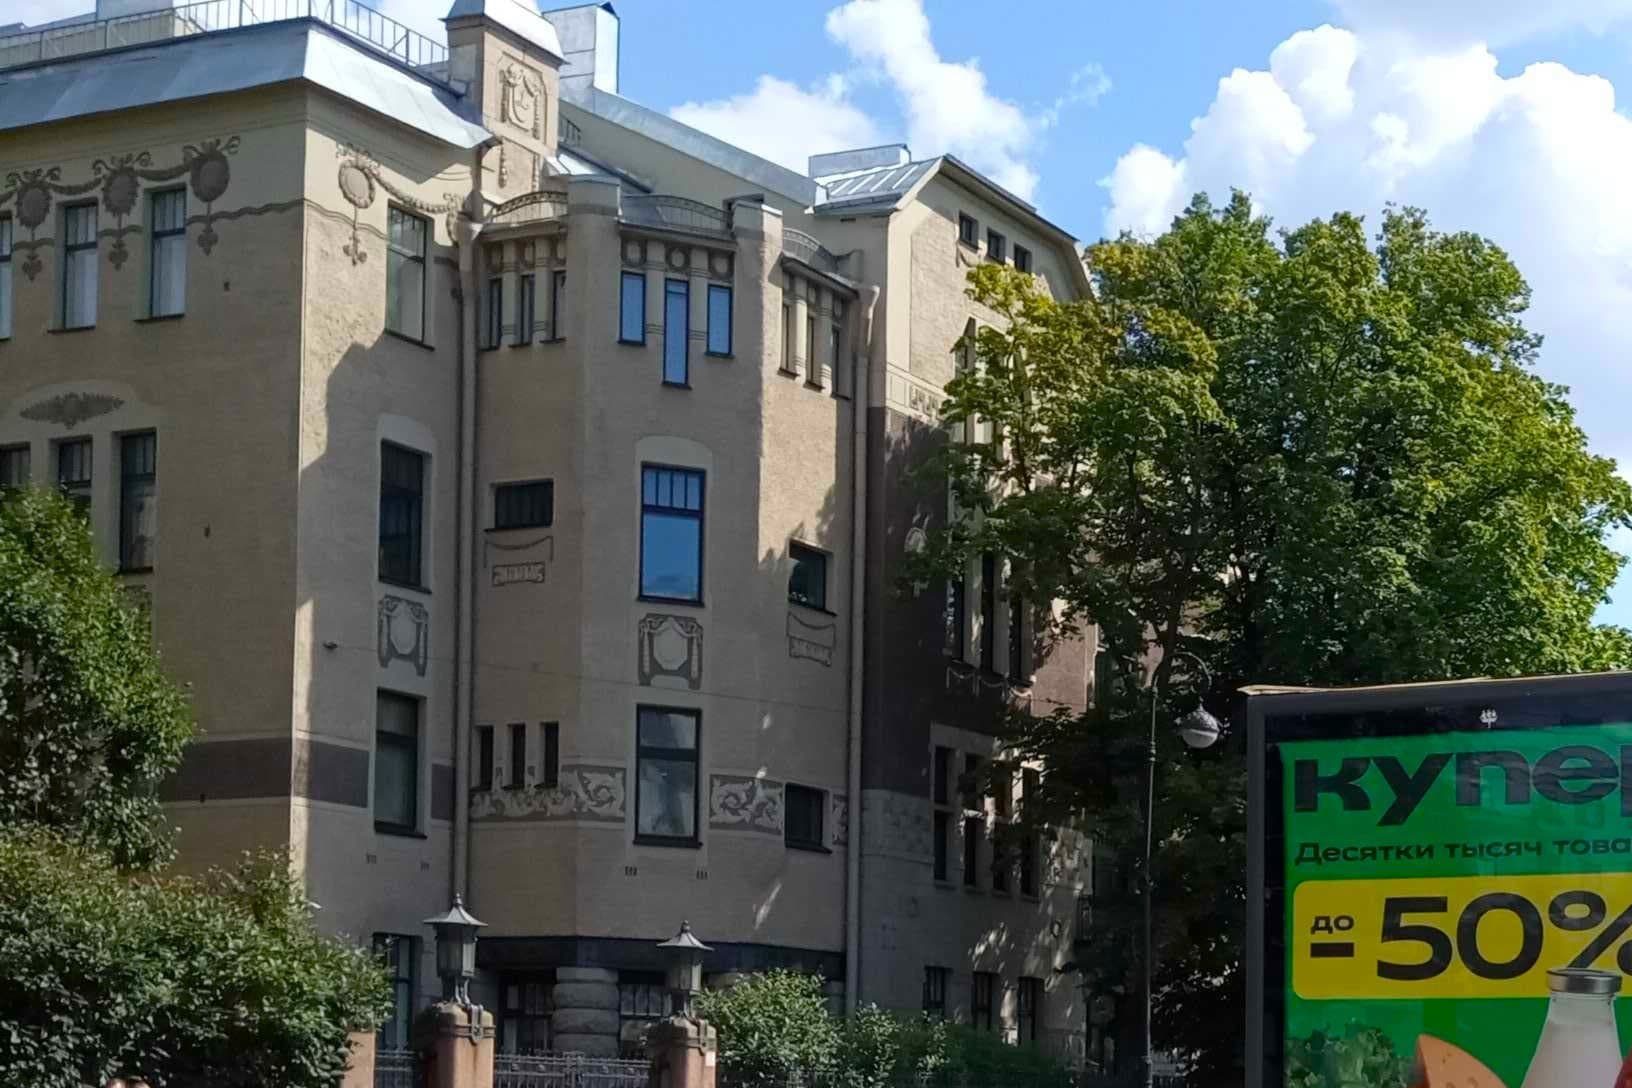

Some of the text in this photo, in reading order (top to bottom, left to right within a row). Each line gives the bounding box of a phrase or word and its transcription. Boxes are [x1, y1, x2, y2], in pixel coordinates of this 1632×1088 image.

[1294, 841, 1435, 867] Десятки
[1444, 840, 1543, 860] тысяч
[1310, 914, 1355, 935] до
